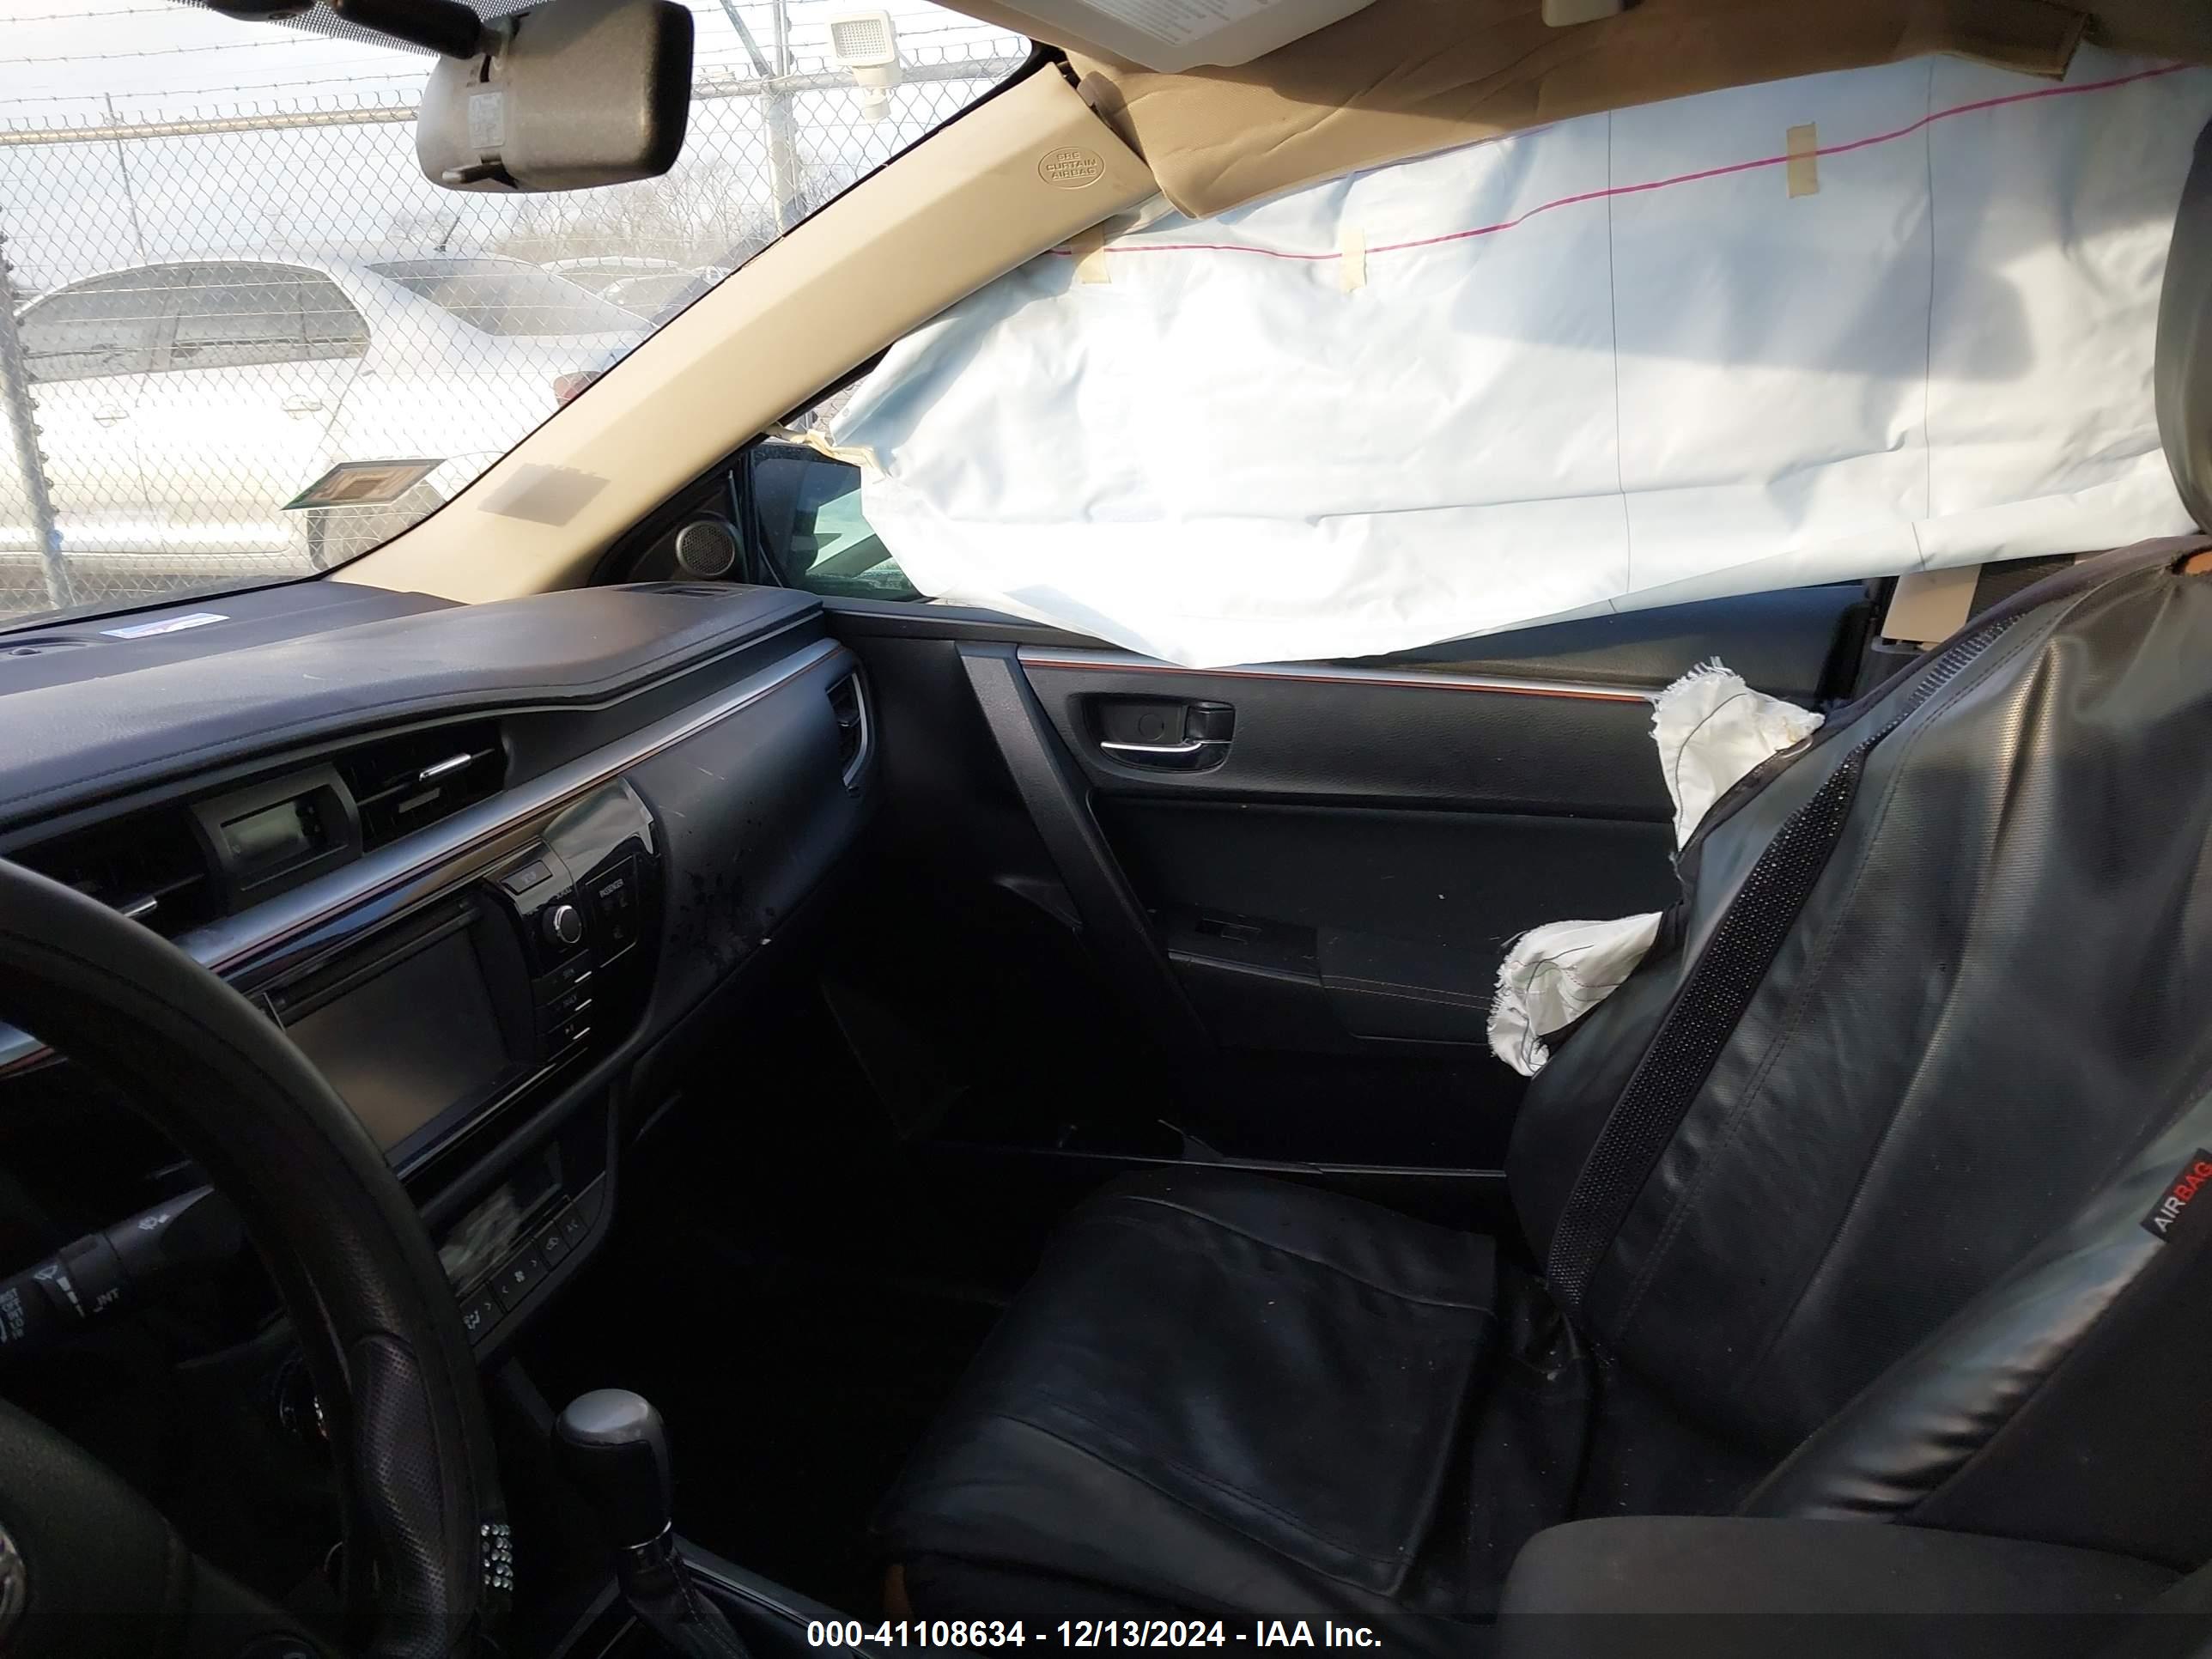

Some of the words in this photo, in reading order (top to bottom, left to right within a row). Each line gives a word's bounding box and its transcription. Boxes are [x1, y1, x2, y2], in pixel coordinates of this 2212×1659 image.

[1046, 158, 1097, 171] CURTAIN
[1052, 167, 1097, 179] AIRBAG
[2154, 1162, 2212, 1232] AIRBAG
